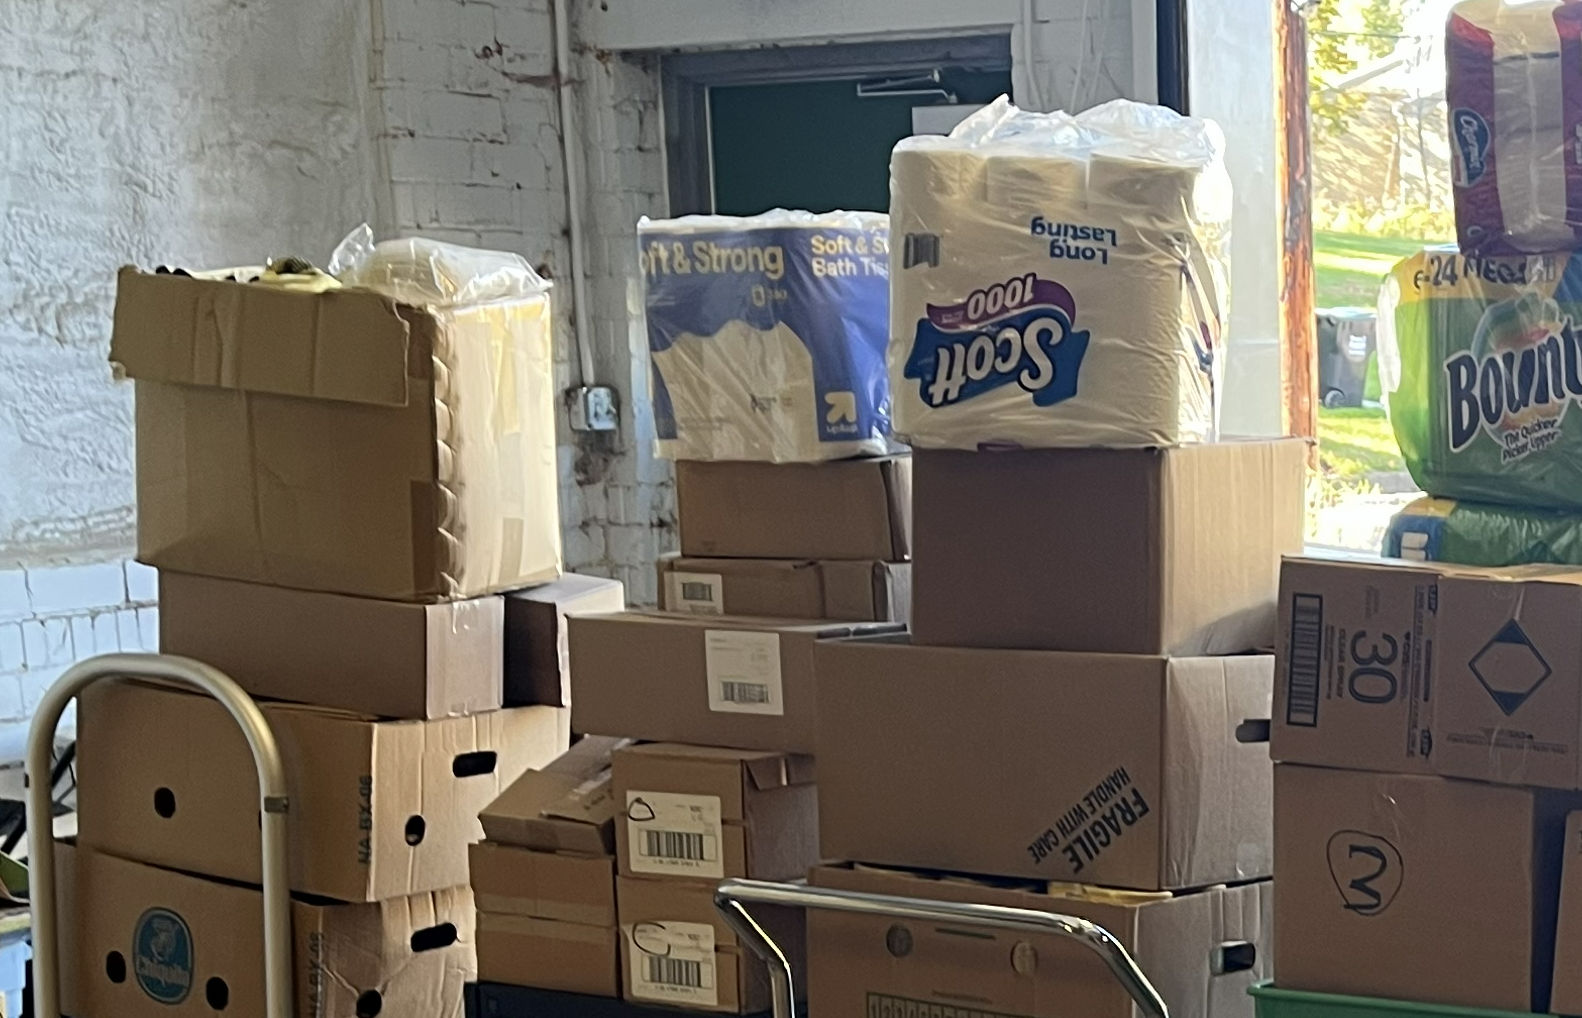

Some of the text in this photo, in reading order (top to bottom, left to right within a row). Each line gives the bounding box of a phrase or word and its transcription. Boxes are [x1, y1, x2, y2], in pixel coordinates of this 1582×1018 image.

[811, 234, 854, 255] Soft
[1031, 216, 1117, 246] Lasting
[1050, 239, 1108, 264] Long
[638, 240, 785, 280] oft & Strong
[812, 258, 858, 278] Bath
[966, 274, 1036, 320] 1000
[928, 316, 1064, 405] Scott
[1349, 630, 1398, 704] 30
[1027, 766, 1131, 864] HANDLE WITH CARE
[1062, 787, 1150, 874] FRAGILE
